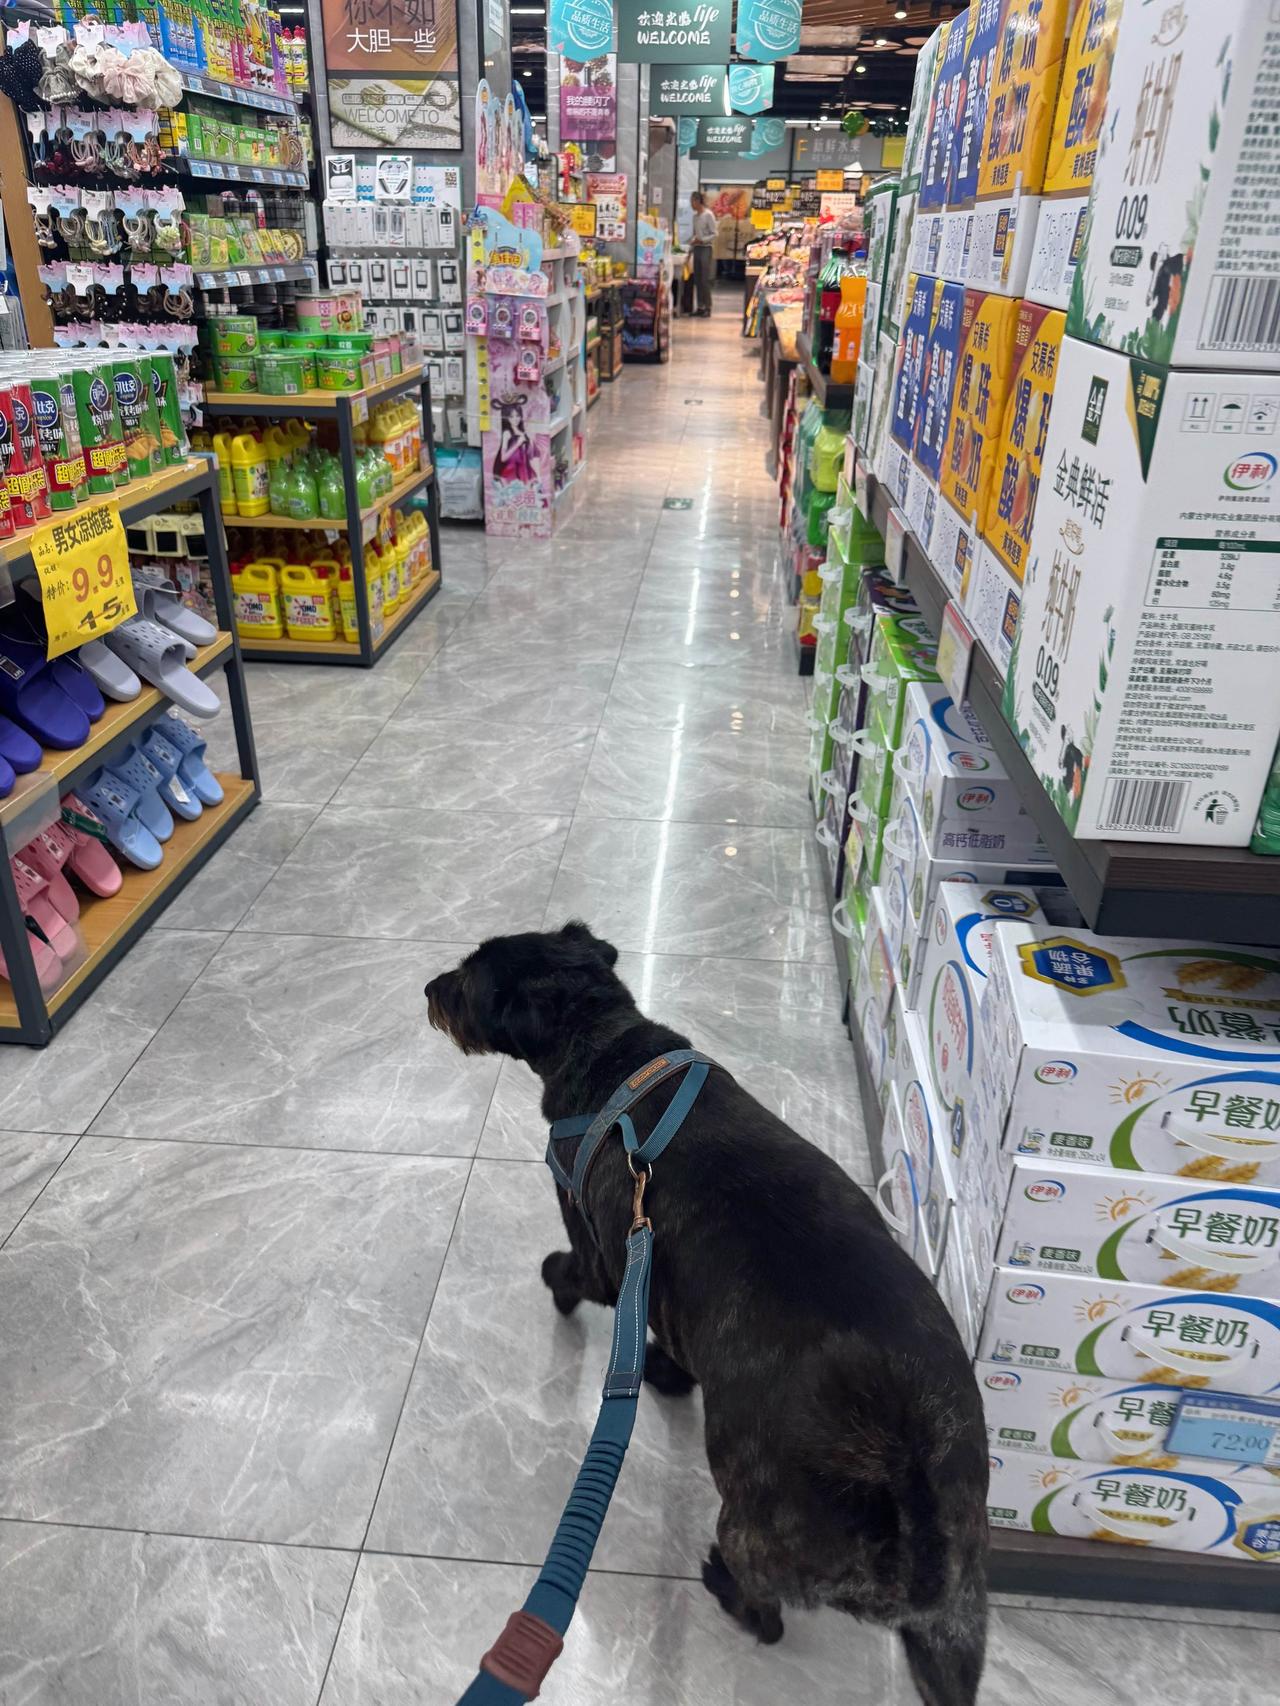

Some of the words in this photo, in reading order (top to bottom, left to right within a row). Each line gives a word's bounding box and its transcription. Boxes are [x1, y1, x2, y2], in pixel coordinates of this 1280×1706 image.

[345, 0, 435, 26] 你不如
[571, 9, 611, 34] 品质生活
[636, 11, 692, 27] 欢迎光临
[693, 4, 720, 31] life
[759, 10, 799, 35] 品质生活
[346, 28, 436, 53] 大胆一些
[636, 31, 711, 45] WELCOME
[660, 92, 712, 103] WELCOME
[345, 108, 415, 124] WELCOME
[419, 109, 440, 124] TO
[706, 136, 744, 144] WELCOME
[1115, 194, 1149, 241] 0.09
[1030, 338, 1057, 381] 安慕希
[1231, 463, 1271, 480] 伊利
[1052, 448, 1111, 531] 金典鲜活
[52, 505, 114, 555] 男女凉拖鞋
[46, 580, 70, 601] 特价：
[72, 554, 114, 603] 9.9
[79, 595, 122, 630] 45
[1035, 644, 1061, 698] 0.09
[942, 832, 1006, 850] 高钙低脂奶
[1166, 1003, 1280, 1044] 餐奶
[1038, 1065, 1073, 1080] 伊利
[1168, 1206, 1278, 1249] 早餐奶
[1142, 1308, 1251, 1348] 早餐奶
[1212, 1432, 1271, 1452] 72.00
[1091, 1478, 1189, 1514] 早餐奶
